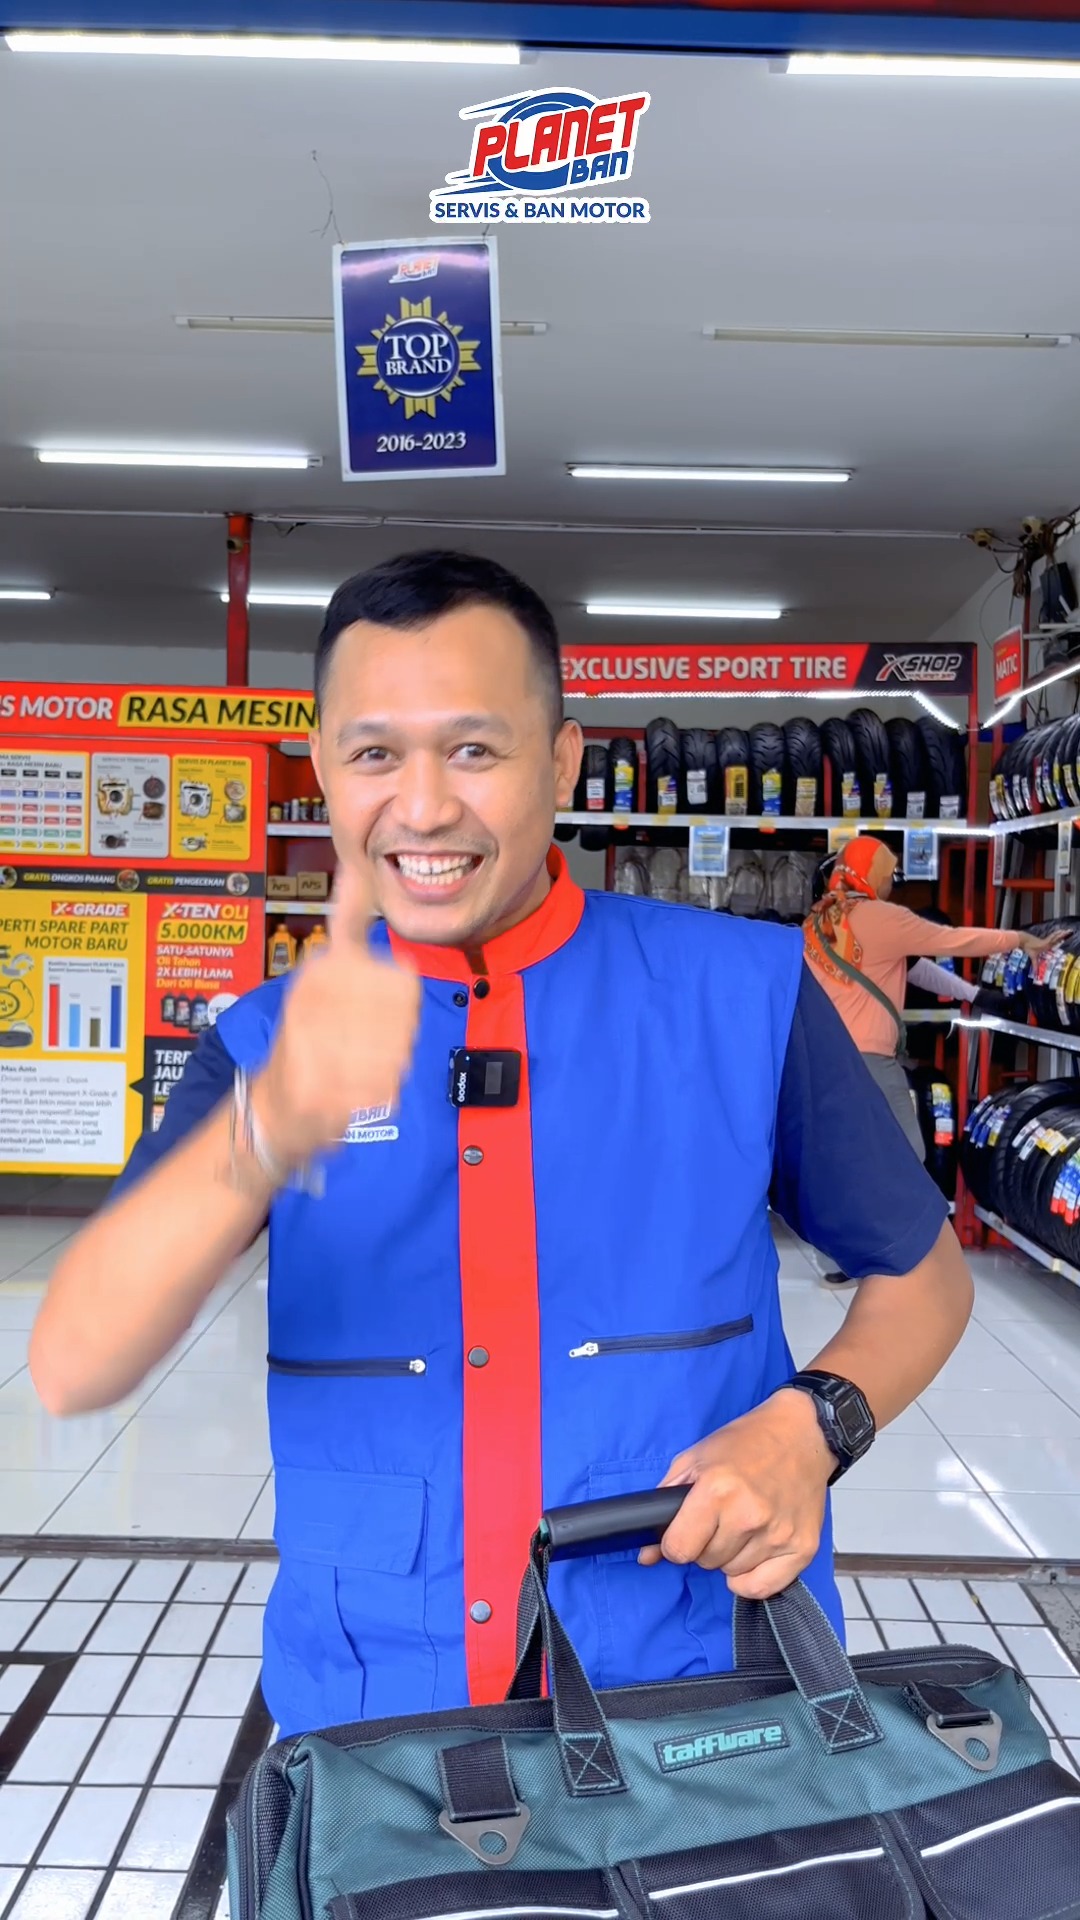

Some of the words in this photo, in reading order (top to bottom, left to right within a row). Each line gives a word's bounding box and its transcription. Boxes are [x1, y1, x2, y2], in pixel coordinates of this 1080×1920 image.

[383, 333, 450, 360] TOP
[385, 358, 451, 377] BRAND
[376, 432, 467, 452] 2016-2023
[560, 656, 690, 681] EXCLUSIVE
[697, 656, 783, 680] SPORT
[789, 656, 847, 680] TIRE
[996, 652, 1019, 681] MATIC
[0, 694, 16, 718] S
[20, 695, 113, 720] MOTOR
[126, 696, 209, 724] RASA
[217, 698, 317, 728] MESIN
[53, 902, 128, 917] X-GRADE
[162, 902, 222, 919] X-TEN
[221, 903, 249, 920] OLI
[39, 919, 87, 935] SPARE
[90, 921, 130, 936] PART
[160, 922, 246, 941] 5.000KM
[25, 935, 83, 951] MOTOR
[86, 938, 128, 952] BARU
[156, 945, 234, 958] SATU-SATUNYA
[156, 966, 170, 977] 2X
[172, 967, 201, 978] LEBIH
[203, 968, 234, 980] LAMA
[154, 1081, 178, 1096] LE
[457, 1071, 467, 1103] Godox
[357, 1129, 395, 1140] MOTOR
[662, 1725, 783, 1765] taffware
